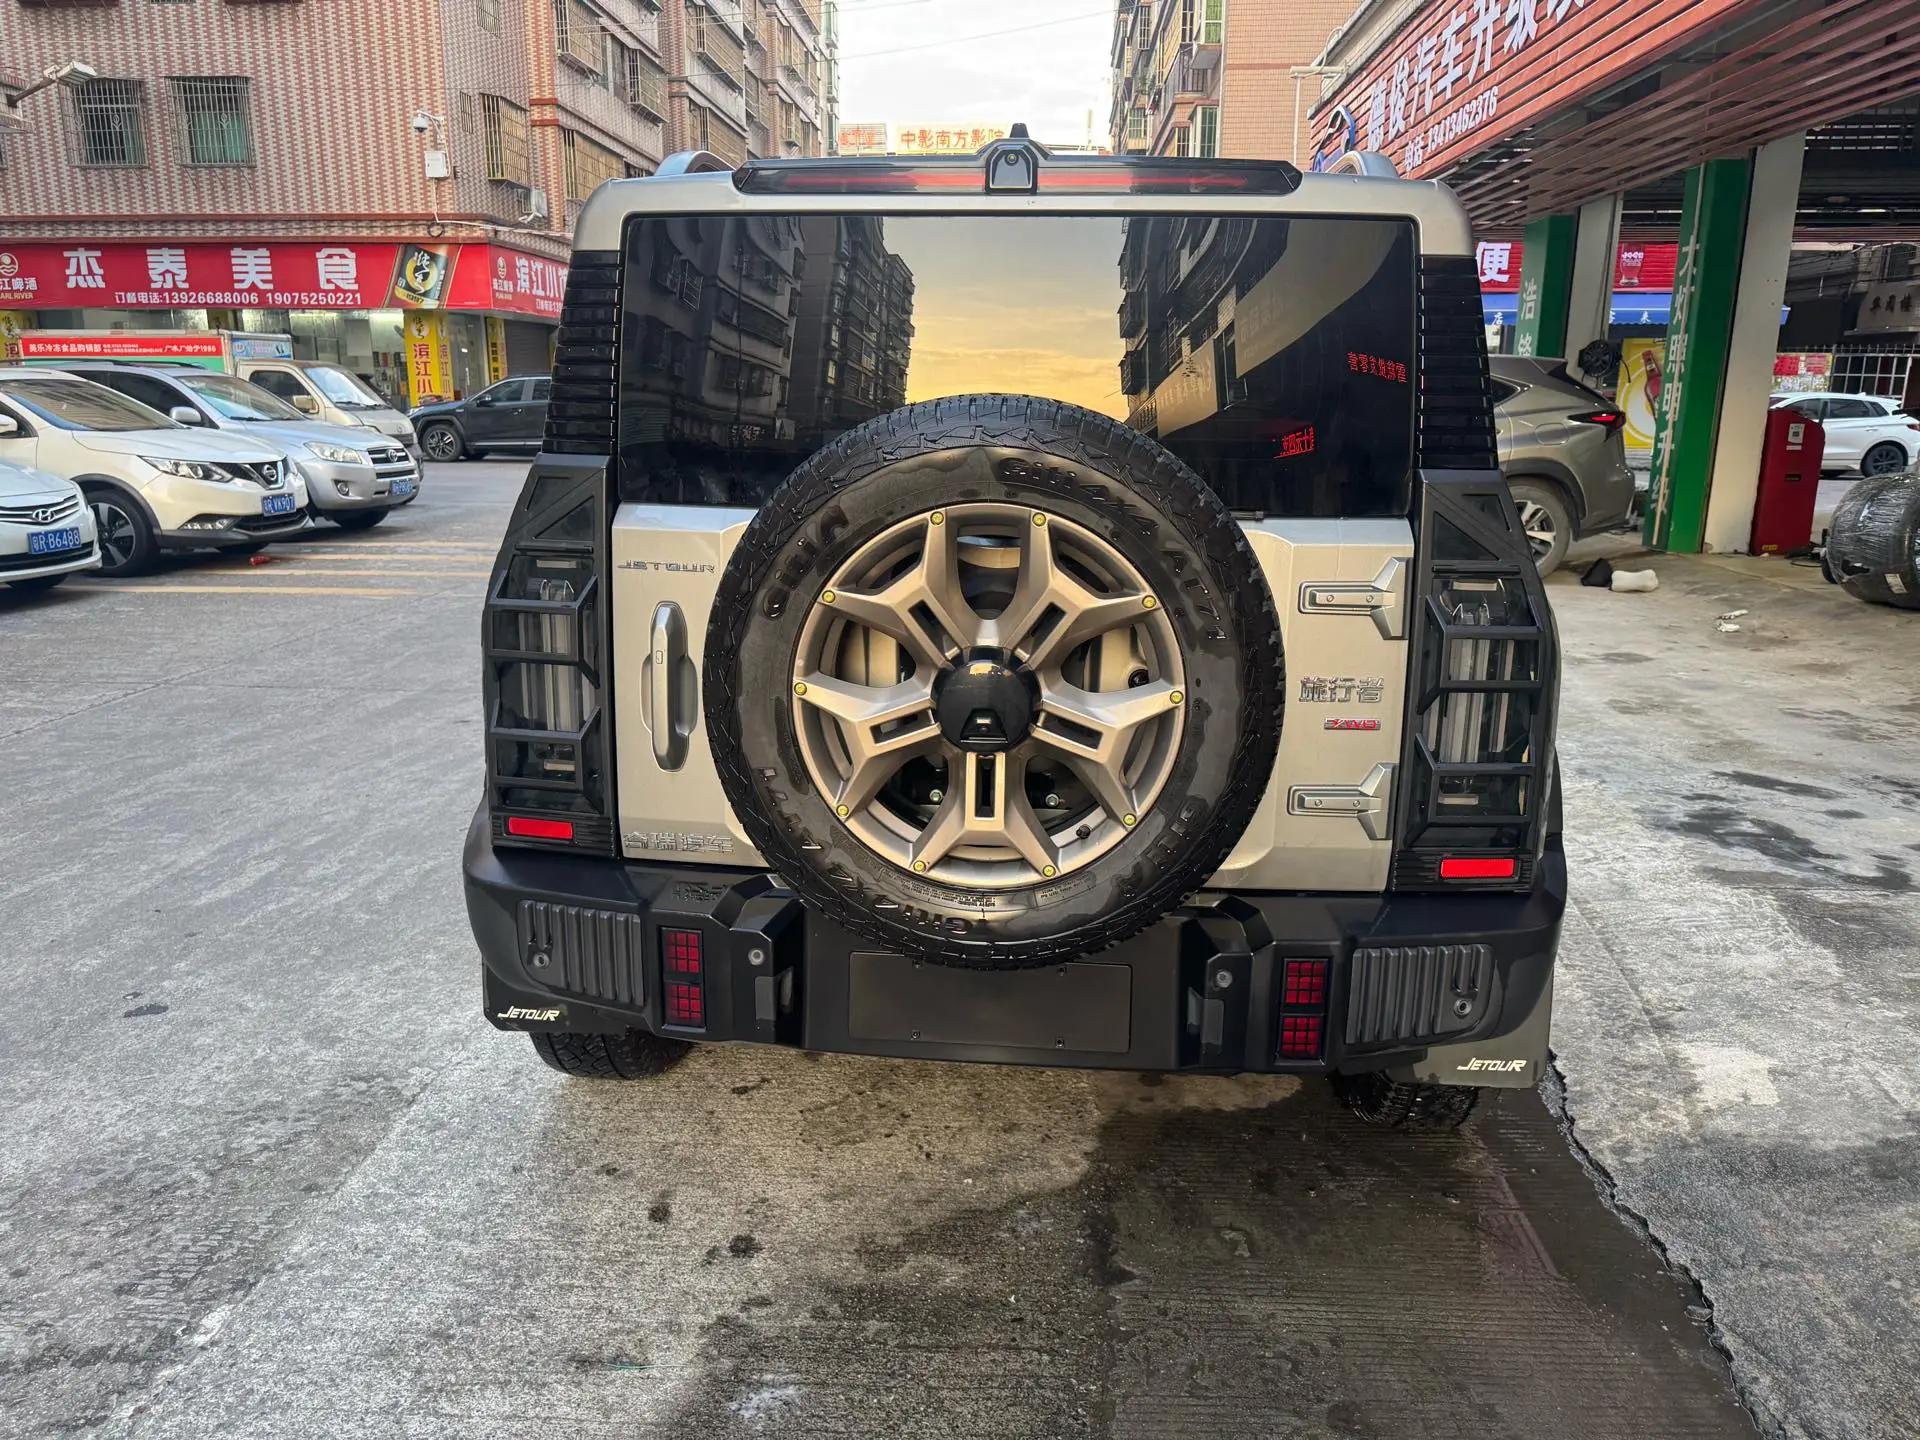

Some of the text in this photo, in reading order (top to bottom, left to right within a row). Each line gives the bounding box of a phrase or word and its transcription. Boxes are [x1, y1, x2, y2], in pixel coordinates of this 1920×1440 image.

[1367, 0, 1584, 152] 德俊汽车升级
[1428, 86, 1498, 152] 13413462376
[62, 247, 359, 290] 杰泰美食
[266, 293, 361, 305] 19075250221
[617, 560, 714, 573] JETOUR
[1299, 675, 1384, 703] 旅行者
[621, 832, 734, 853] 奇瑞汽车
[497, 1005, 561, 1021] JETOUR
[1457, 1057, 1528, 1071] JETOUR
